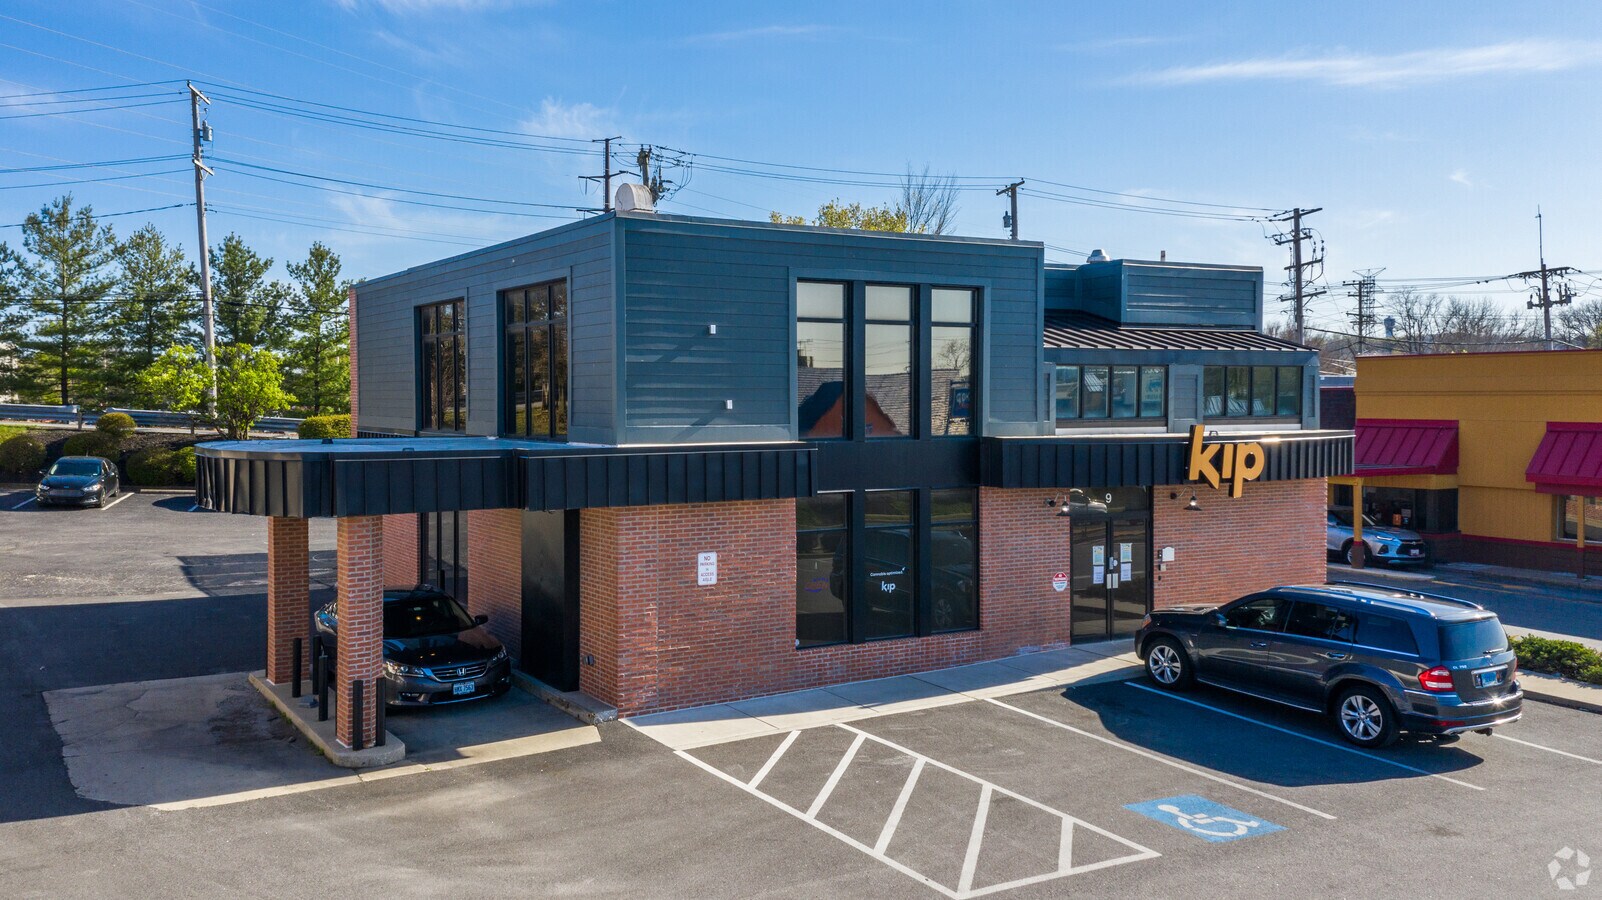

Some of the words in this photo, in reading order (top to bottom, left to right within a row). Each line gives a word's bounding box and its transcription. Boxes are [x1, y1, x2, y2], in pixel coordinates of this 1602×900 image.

[1189, 424, 1265, 498] kip
[1105, 492, 1112, 504] 9
[881, 580, 896, 593] kip
